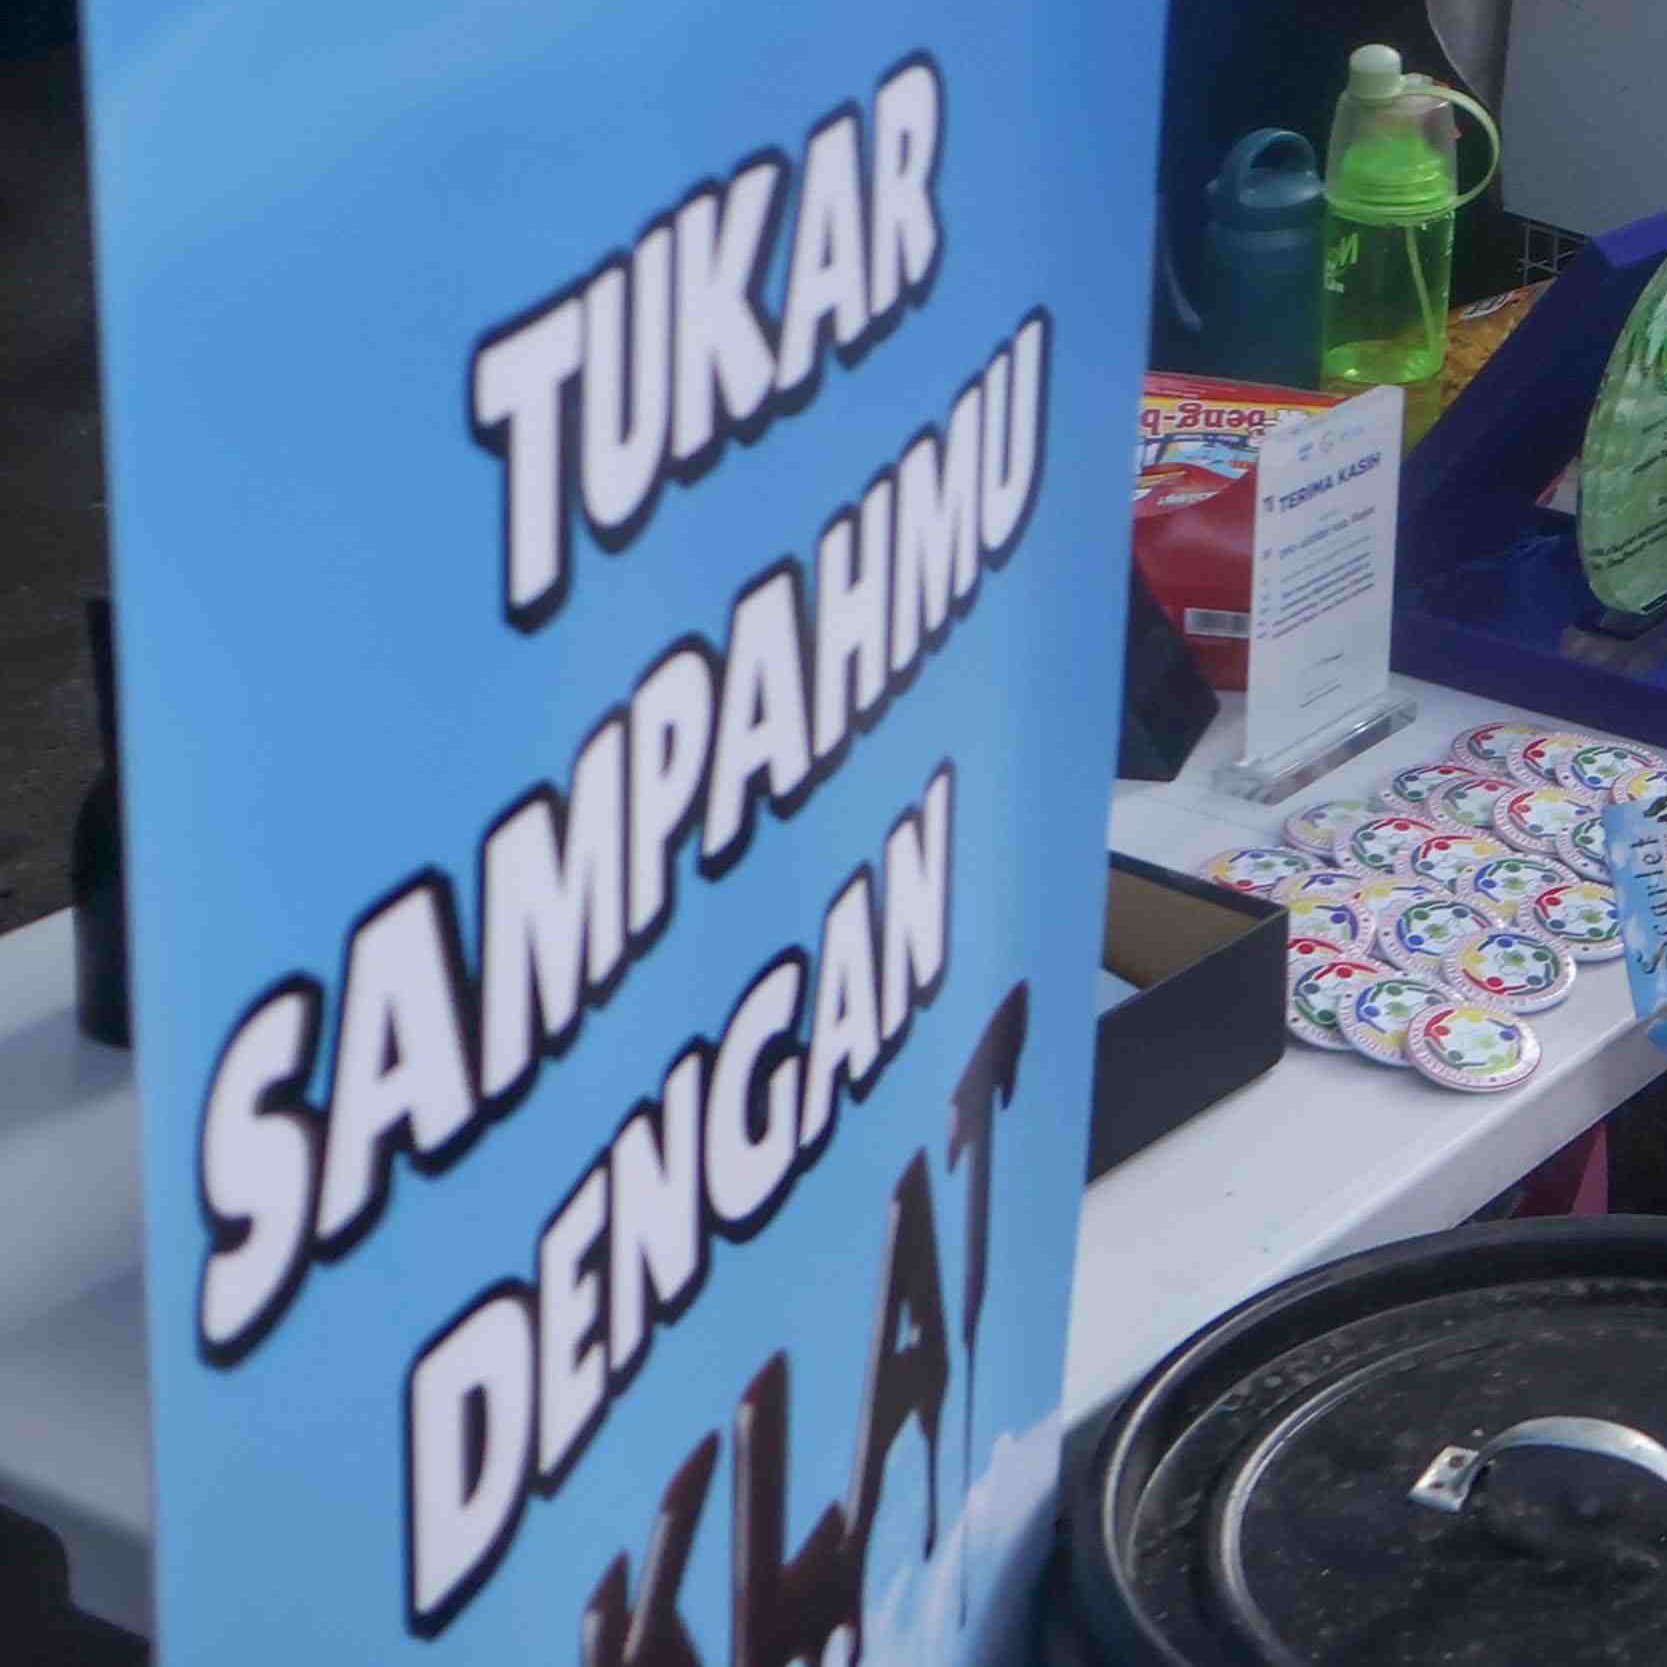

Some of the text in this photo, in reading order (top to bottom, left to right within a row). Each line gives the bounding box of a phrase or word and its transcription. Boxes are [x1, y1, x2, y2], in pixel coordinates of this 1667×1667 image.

[472, 54, 940, 624] TUKAR
[198, 314, 1048, 1356] SAMPAHMU
[406, 762, 954, 1629] DENGAN
